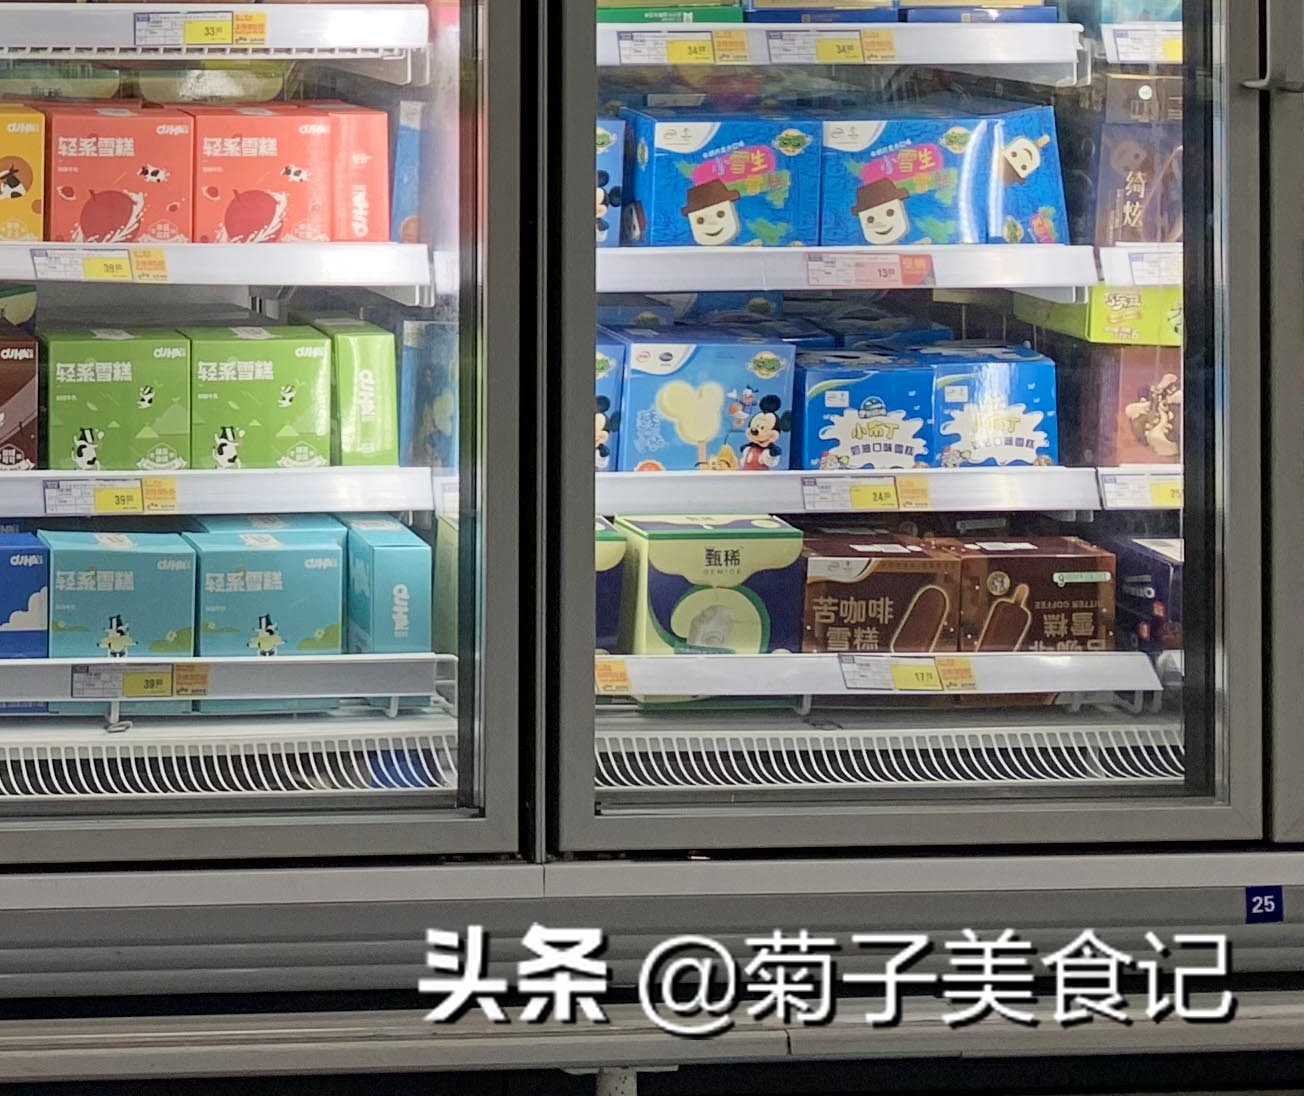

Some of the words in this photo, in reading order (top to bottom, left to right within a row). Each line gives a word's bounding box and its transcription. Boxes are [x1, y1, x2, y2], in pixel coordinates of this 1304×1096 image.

[56, 361, 133, 383] 轻系雪糕
[198, 360, 274, 383] 轻系雪糕
[704, 547, 741, 568] 甄稀
[813, 596, 894, 625] 苦咖啡
[826, 627, 880, 652] 雪糕
[1251, 895, 1276, 915] 25
